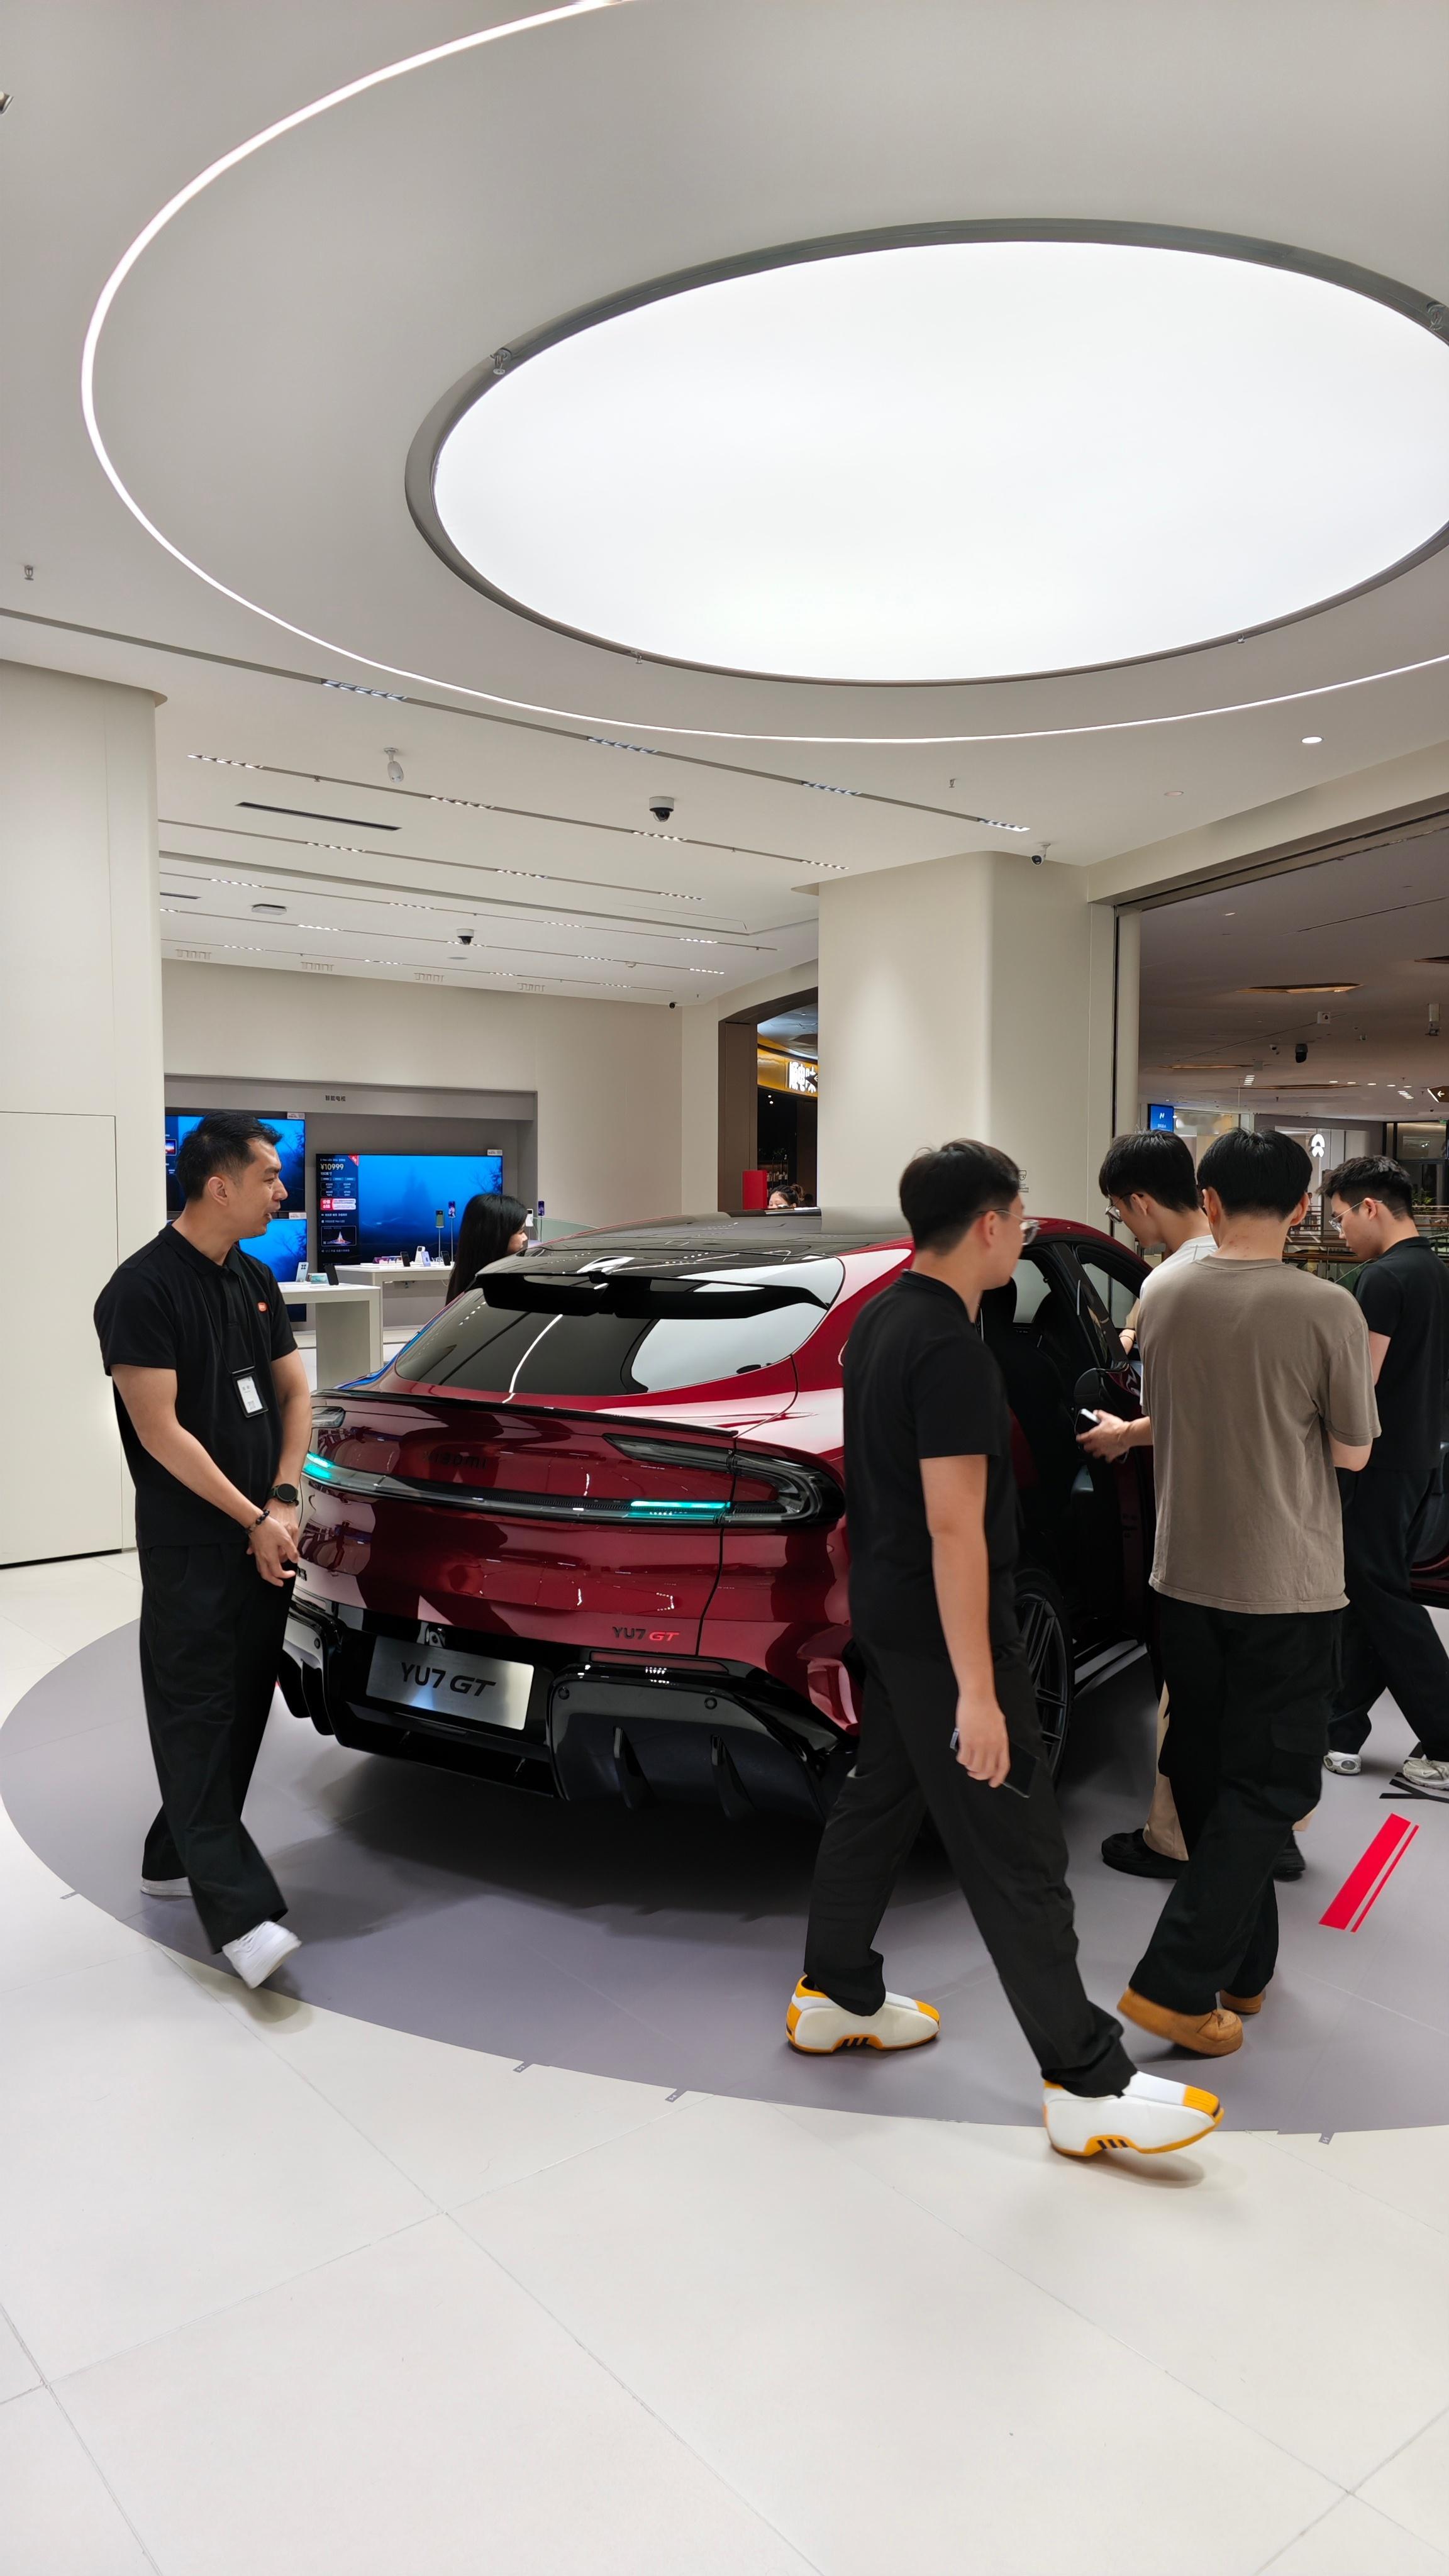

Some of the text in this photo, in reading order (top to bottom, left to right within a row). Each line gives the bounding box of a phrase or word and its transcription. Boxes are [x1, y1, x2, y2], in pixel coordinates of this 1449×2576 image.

[612, 1626, 680, 1641] YU7 GT
[401, 1662, 497, 1697] YU7 GT
